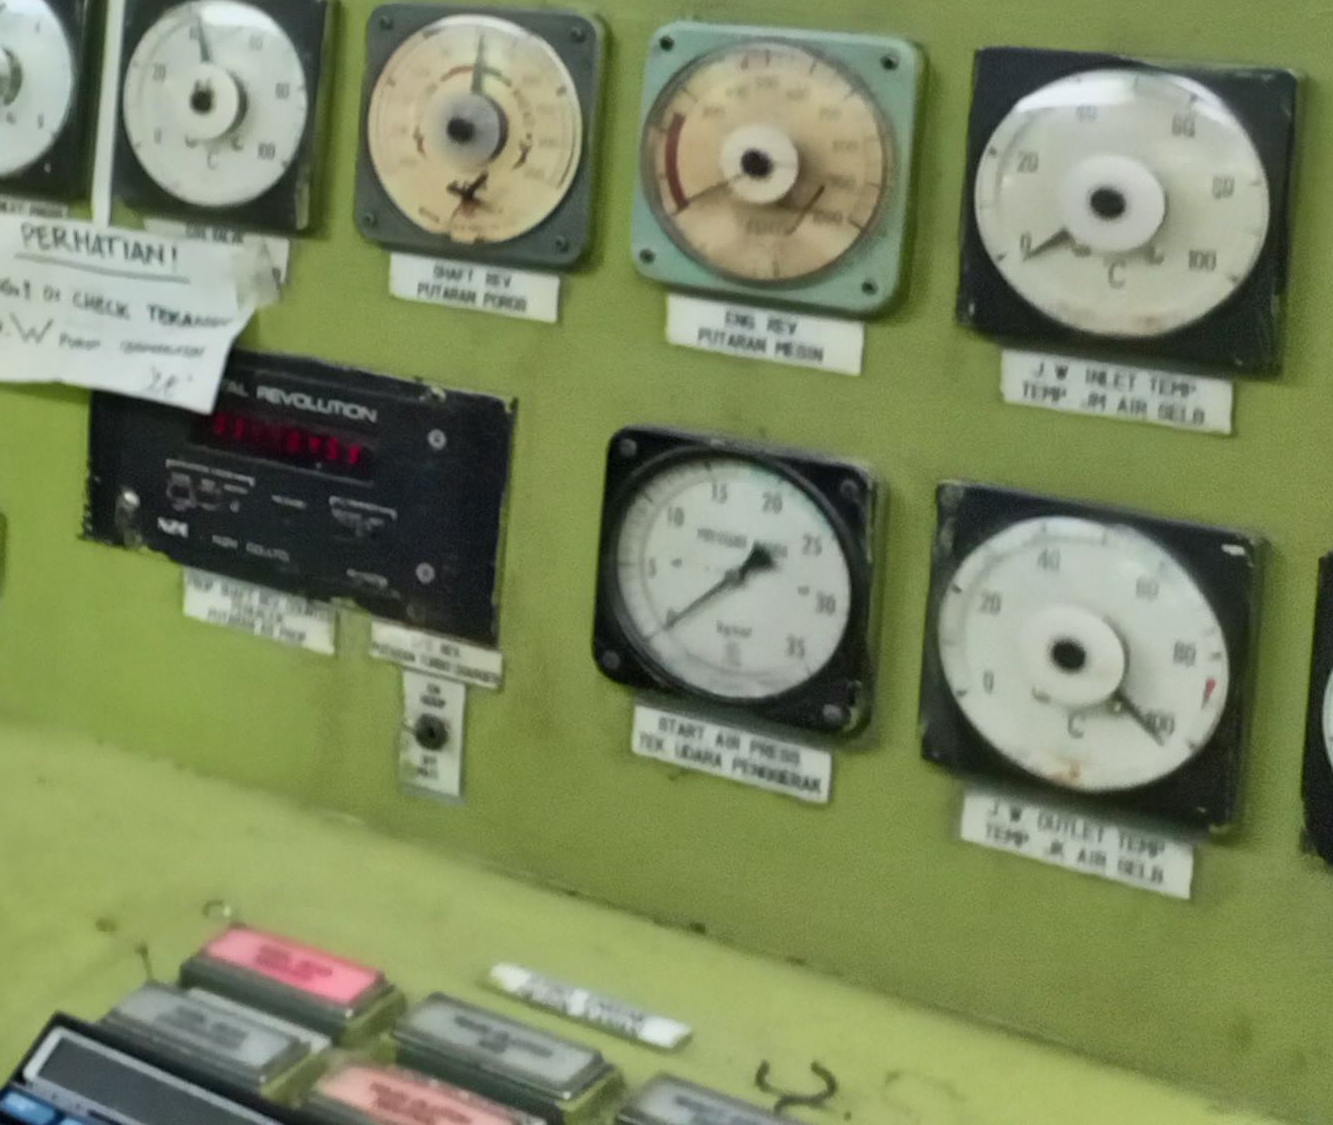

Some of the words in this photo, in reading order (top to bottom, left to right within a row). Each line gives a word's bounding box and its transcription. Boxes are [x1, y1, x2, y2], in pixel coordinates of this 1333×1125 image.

[416, 281, 476, 305] PUTARAN
[766, 316, 798, 336] REV
[697, 327, 767, 353] PUTARAN
[774, 340, 825, 363] MESIN
[1022, 379, 1068, 403] TEMP
[1150, 375, 1197, 399] TEMP
[256, 384, 378, 424] REVOLUTION
[657, 715, 706, 742] START
[985, 820, 1030, 848] TEMP
